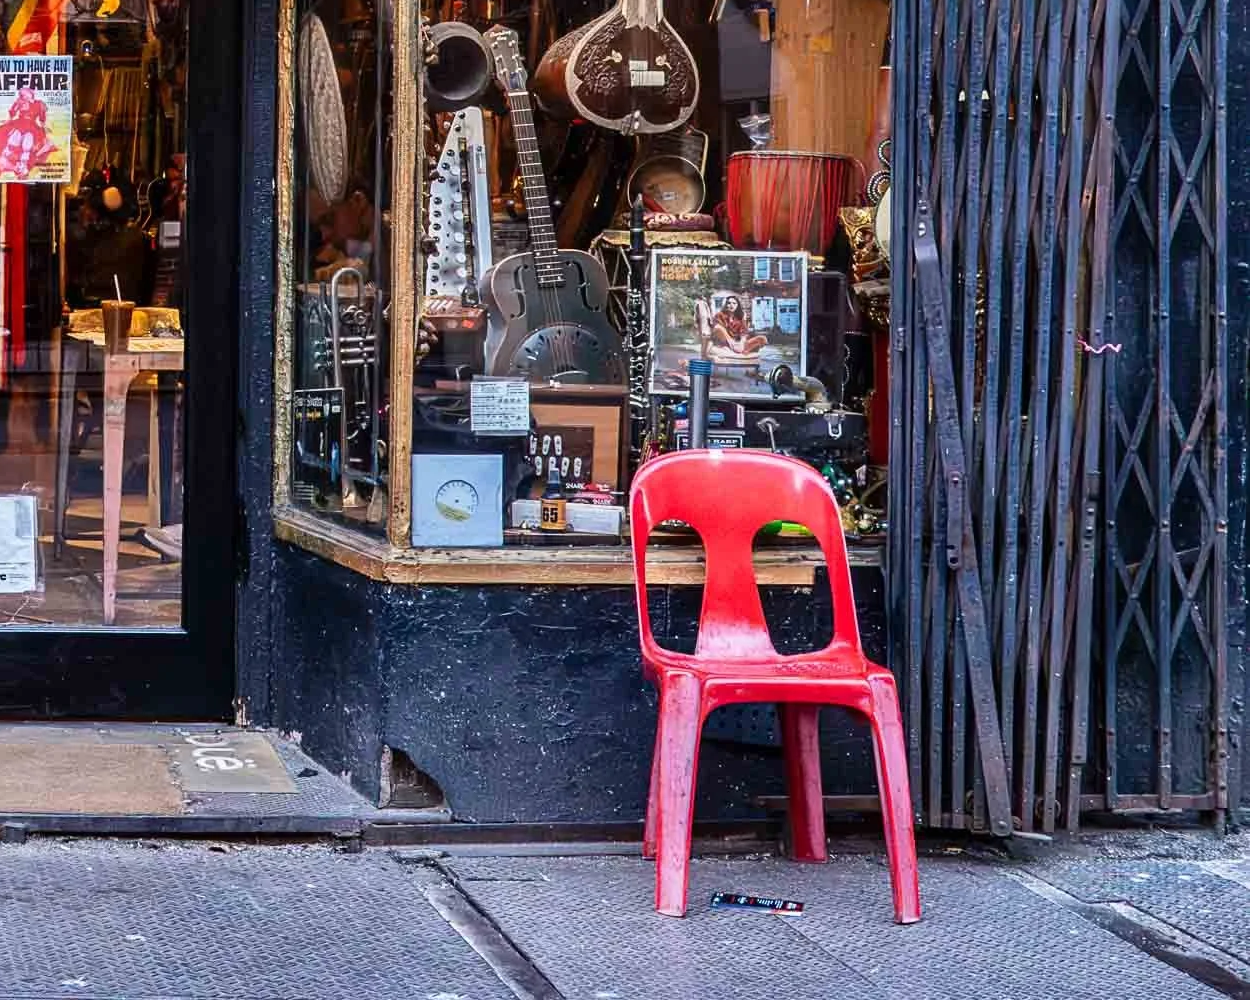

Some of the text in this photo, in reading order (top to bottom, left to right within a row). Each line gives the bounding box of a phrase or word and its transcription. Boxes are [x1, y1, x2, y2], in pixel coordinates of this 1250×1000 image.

[13, 60, 25, 73] TO
[28, 60, 51, 73] HAVE
[53, 60, 68, 73] AN
[542, 507, 558, 523] 65
